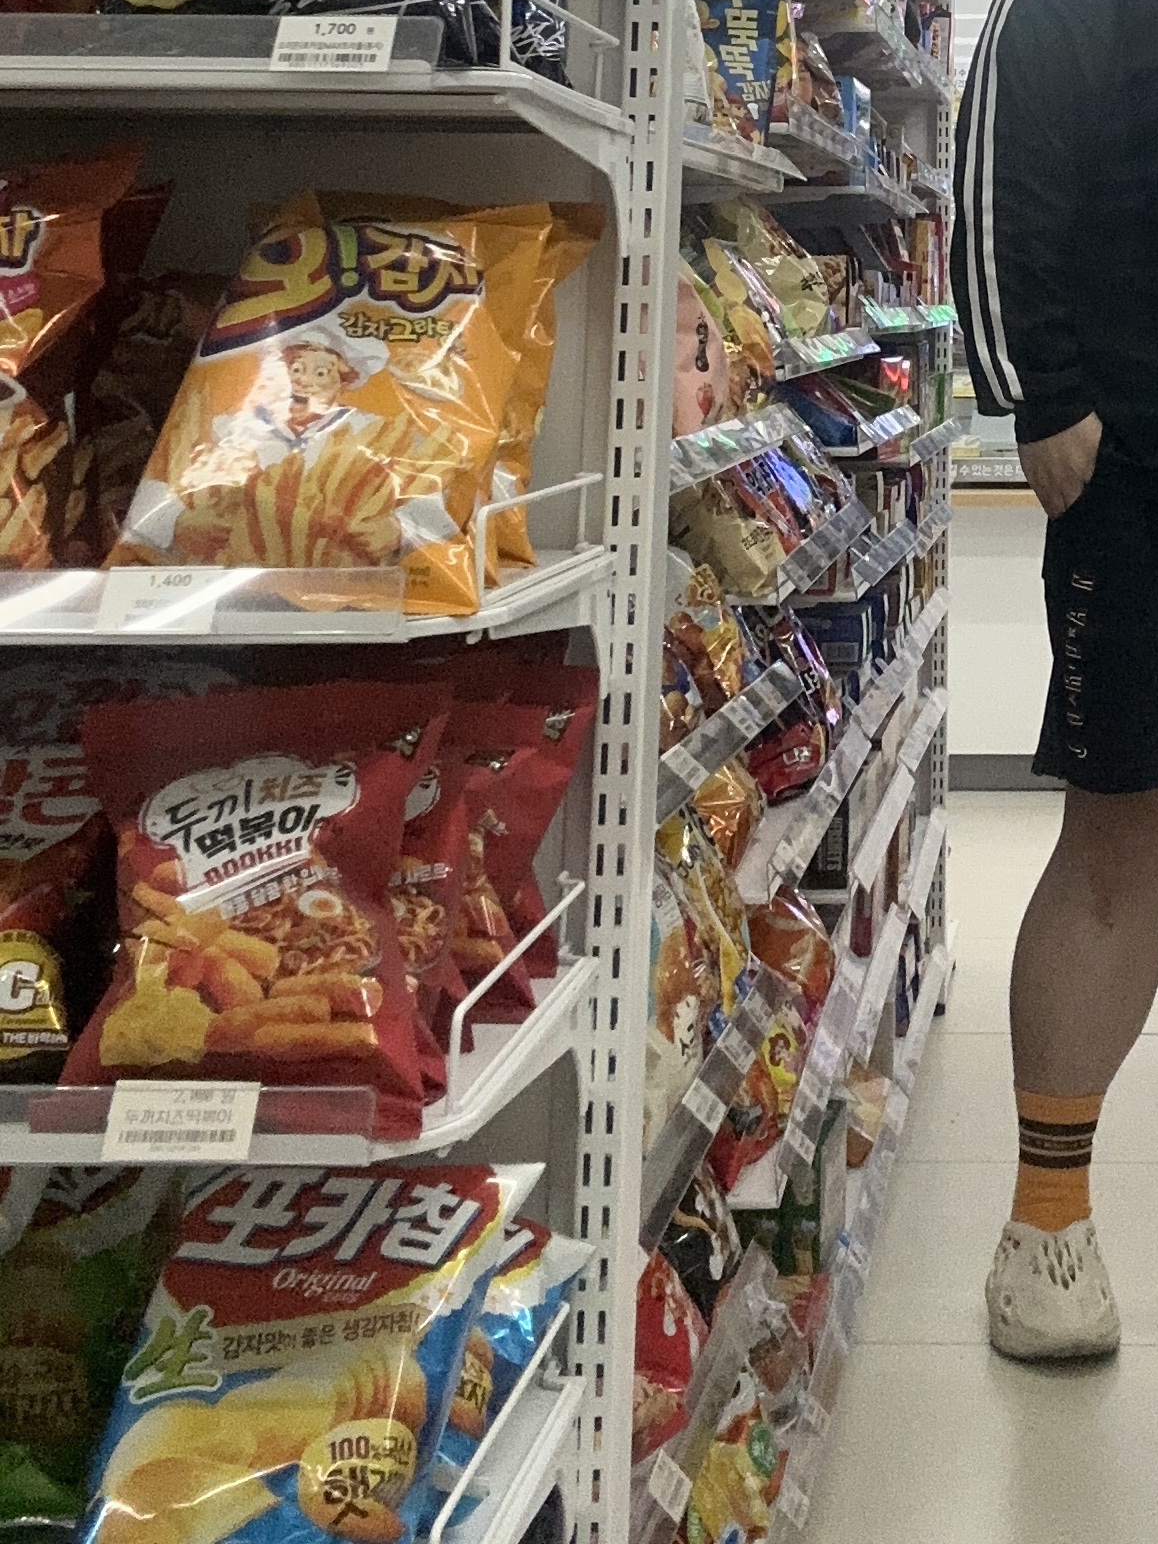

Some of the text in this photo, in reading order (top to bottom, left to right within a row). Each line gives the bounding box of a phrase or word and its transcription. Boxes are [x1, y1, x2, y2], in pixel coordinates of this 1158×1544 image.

[314, 23, 357, 36] 1,700
[148, 574, 193, 588] 1,400
[160, 778, 255, 854] 두끼
[257, 773, 328, 805] 치즈
[194, 803, 322, 860] 떡볶이
[177, 1175, 484, 1267] 포카칩
[272, 1266, 378, 1299] Original
